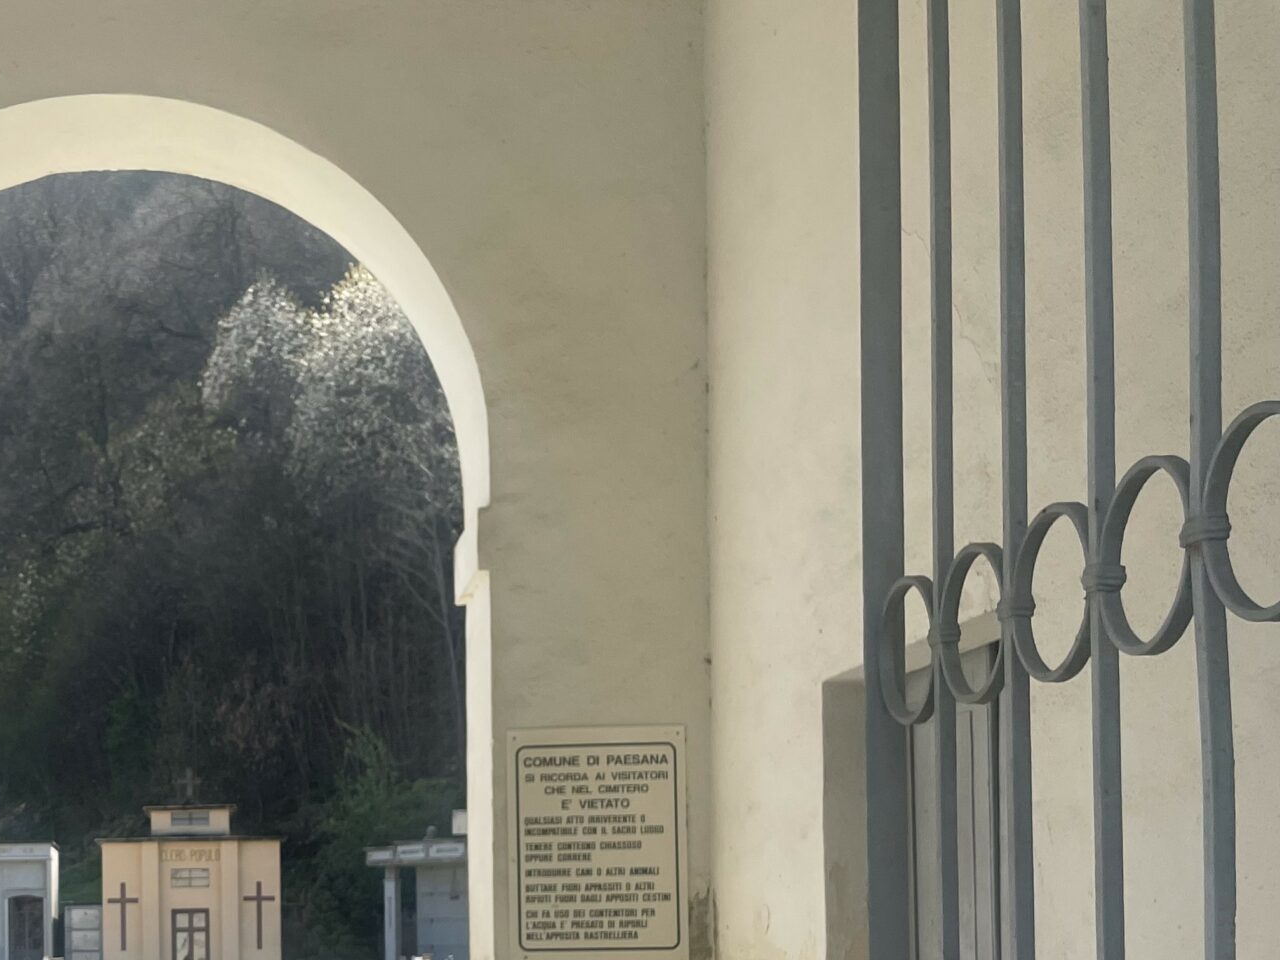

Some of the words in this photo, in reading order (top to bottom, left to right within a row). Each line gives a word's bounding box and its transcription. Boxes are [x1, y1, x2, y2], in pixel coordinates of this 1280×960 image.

[524, 756, 580, 768] COMUNE
[587, 755, 600, 767] DI
[606, 754, 668, 766] PAESANA
[525, 773, 535, 782] SI
[540, 772, 589, 781] RICORDA
[595, 772, 605, 781] AI
[611, 771, 668, 780] VISITATORI
[544, 785, 566, 795] CHE
[571, 785, 592, 794] NEL
[598, 783, 649, 794] CIMITERO
[561, 799, 572, 809] E'
[580, 798, 630, 809] VIETATO
[524, 816, 563, 826] QUALSIASI
[566, 815, 584, 824] ATTO
[588, 815, 636, 823] IRRIVERENTE
[524, 827, 578, 836] INCOMPATIBILE
[582, 826, 597, 835] CON
[601, 826, 608, 834] IL
[612, 825, 636, 834] SACRO
[640, 825, 664, 834] LUOGO
[526, 842, 553, 851] TENERE
[557, 841, 596, 851] CONTEGNO
[600, 841, 642, 850] CHIASSOSO
[525, 853, 553, 863] OPPURE
[557, 853, 592, 862] CORRERE
[525, 868, 571, 878] INTRODURRE
[576, 867, 593, 877] CANI
[606, 867, 625, 876] ALTRI
[629, 867, 659, 876] ANIMALI
[525, 883, 557, 893] BUTTARE
[562, 883, 581, 892] FIORI
[585, 882, 622, 891] APPASSITI
[635, 882, 654, 891] ALTRI
[525, 894, 551, 903] RIFIUTI
[555, 894, 577, 903] FUORI
[581, 893, 602, 902] DAGLI
[606, 893, 638, 902] APPOSITI
[642, 893, 671, 901] CESTINI
[526, 910, 538, 918] CHI
[542, 909, 551, 918] FA
[554, 909, 569, 918] USO
[573, 909, 585, 918] DEI
[589, 908, 637, 917] CONTENITORI
[641, 908, 655, 917] PER
[526, 921, 556, 930] L'ACQUA
[571, 920, 604, 929] PREGATO
[608, 920, 615, 928] DI
[619, 919, 648, 928] RIPORLI
[526, 931, 580, 941] NELL'APPOSITA
[584, 930, 638, 940] RASTRELLIERA
